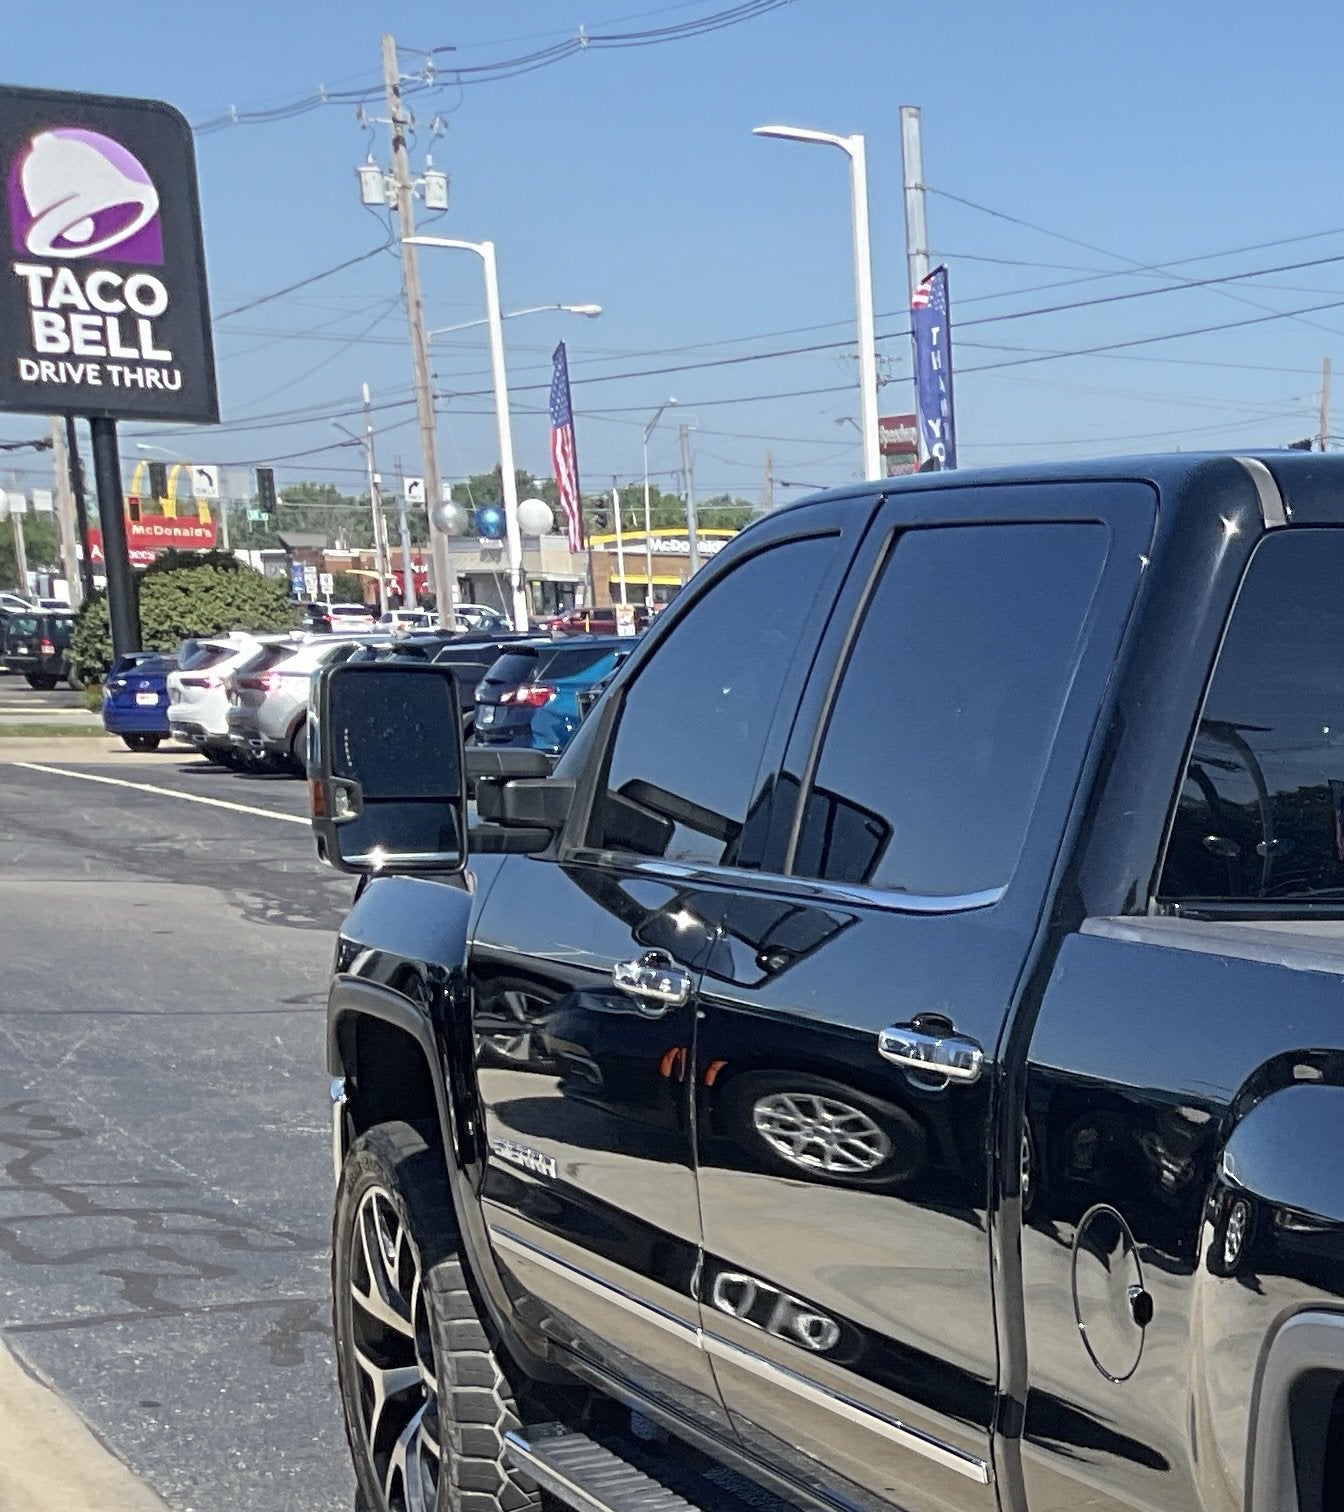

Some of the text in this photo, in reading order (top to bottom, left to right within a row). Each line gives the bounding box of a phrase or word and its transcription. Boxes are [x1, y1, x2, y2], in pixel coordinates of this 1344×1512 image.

[14, 262, 168, 317] TACO
[31, 310, 173, 361] BELL
[18, 358, 182, 391] DRIVE THRU
[131, 524, 213, 538] McDonald's
